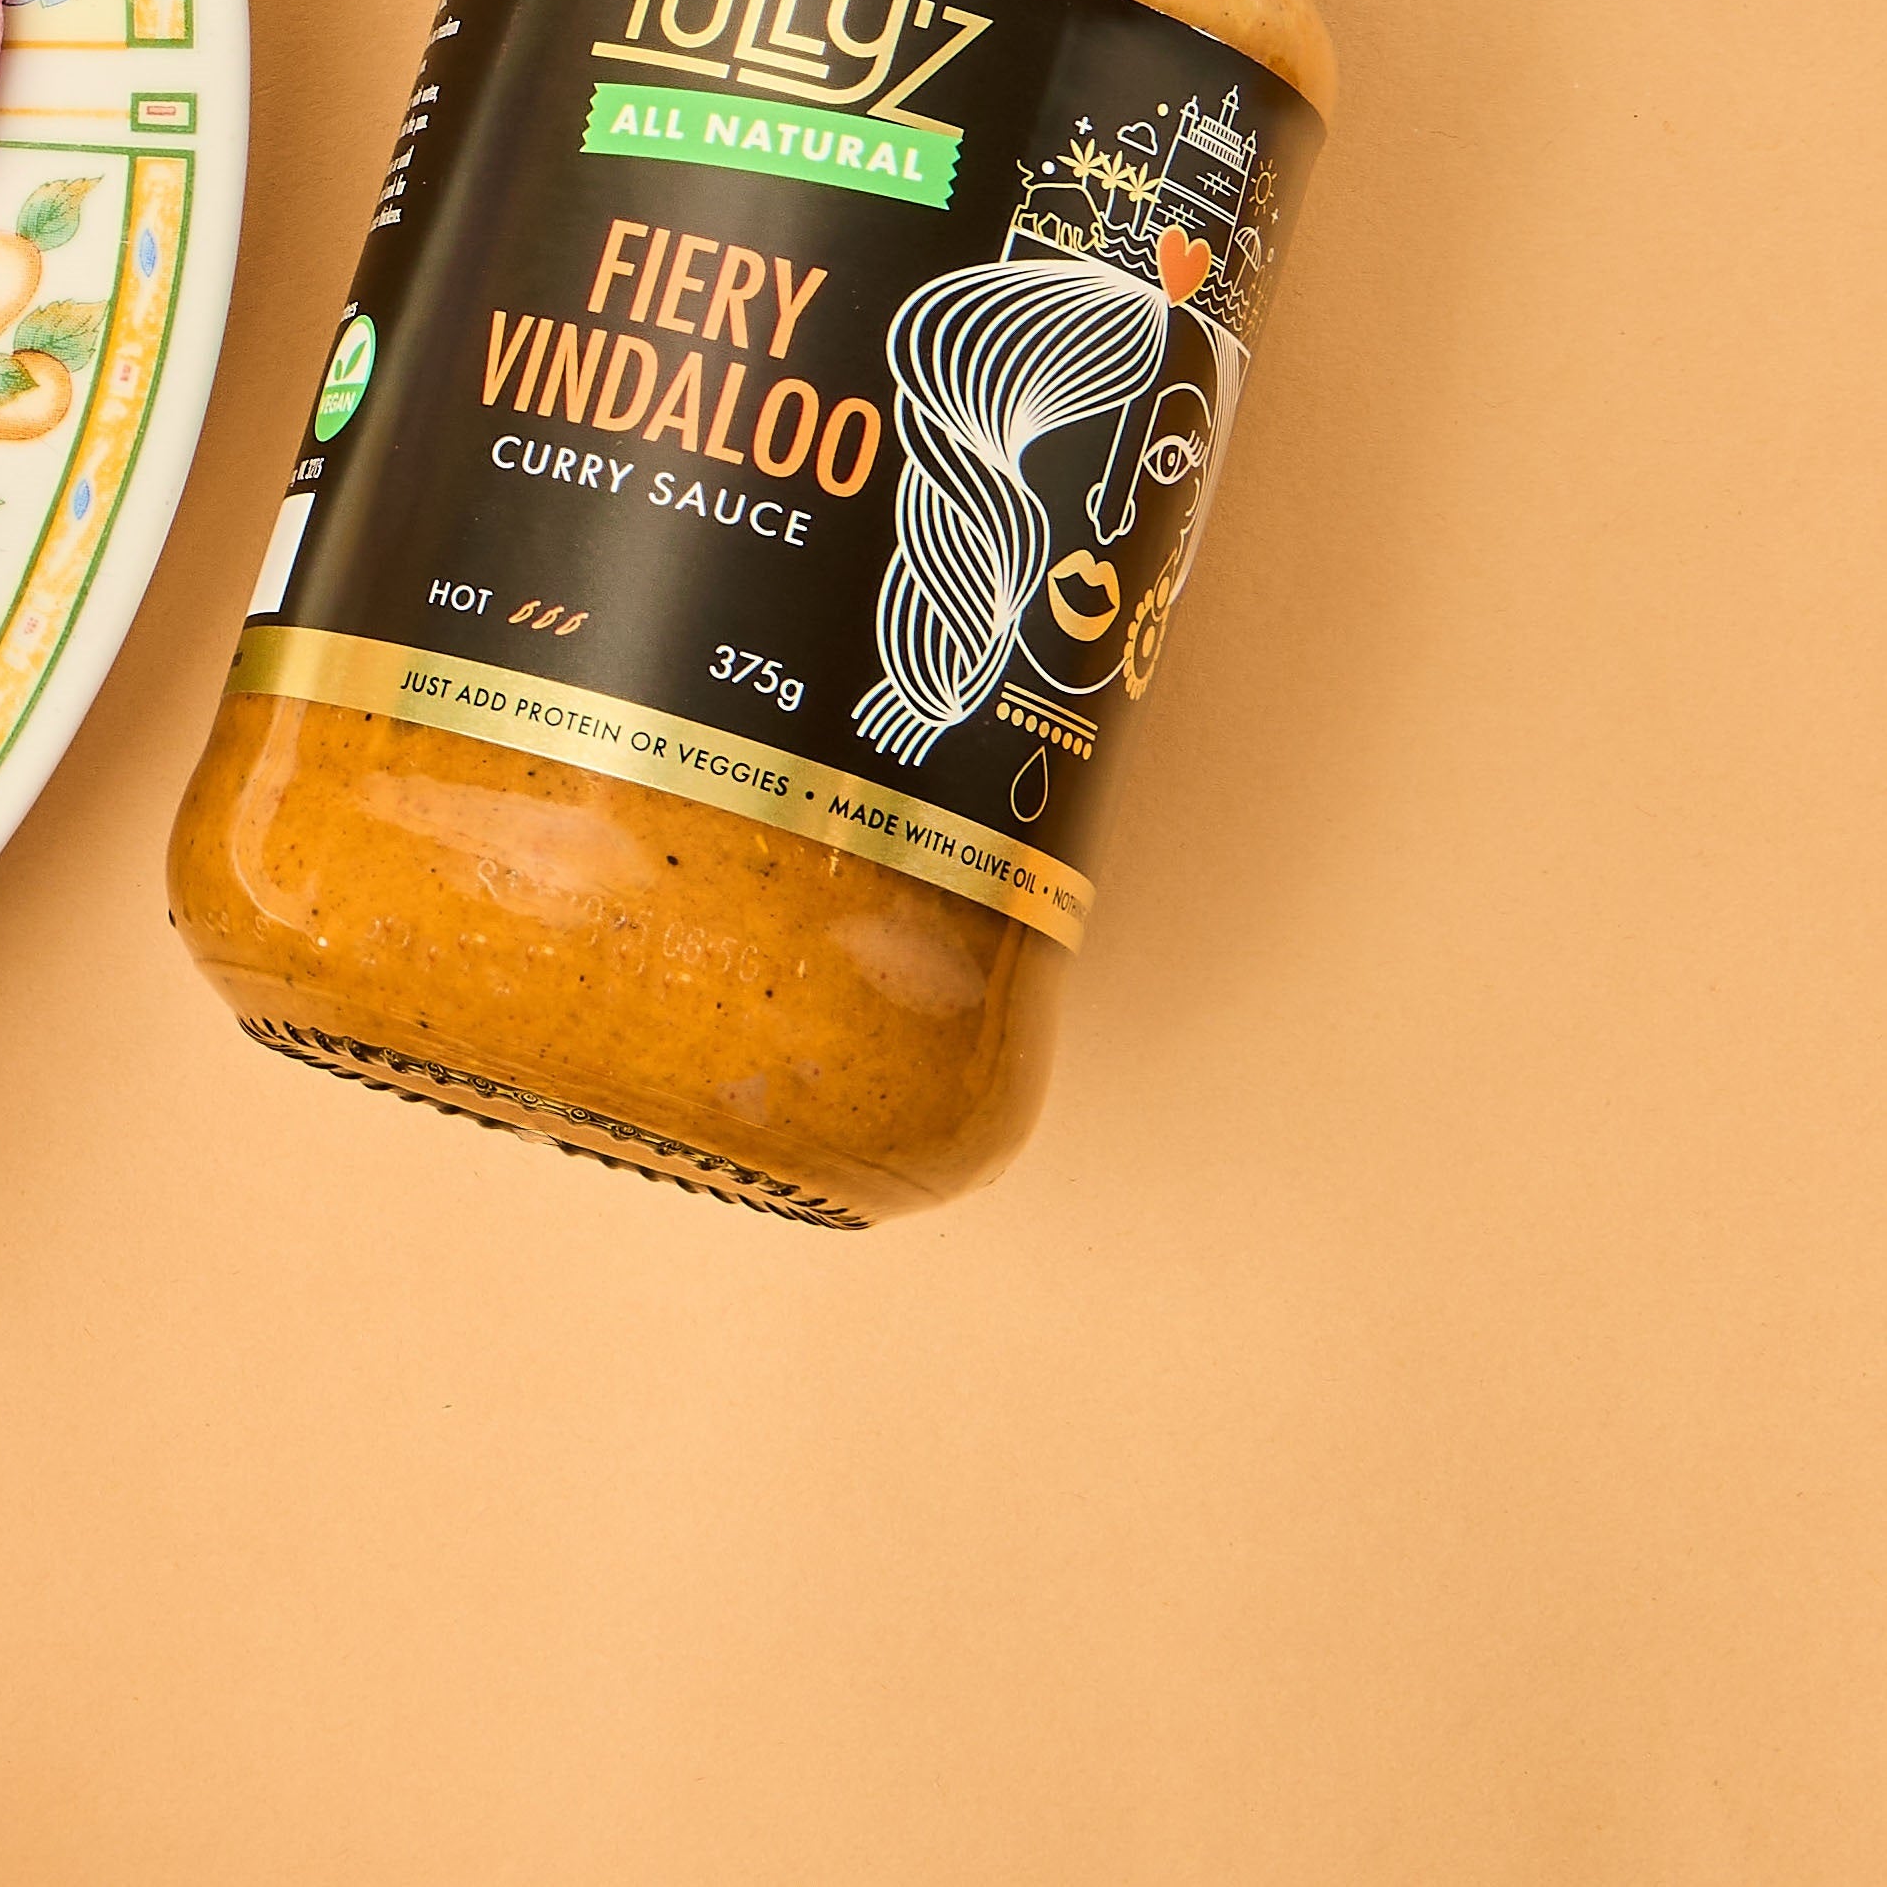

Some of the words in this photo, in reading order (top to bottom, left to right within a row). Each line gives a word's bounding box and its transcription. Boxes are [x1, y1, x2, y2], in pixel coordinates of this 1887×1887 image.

[610, 104, 685, 140] ALL
[704, 112, 924, 182] NATURAL
[587, 218, 828, 360] FIERY
[482, 310, 882, 498] VINDALOO
[491, 435, 634, 493] CURRY
[648, 472, 812, 546] SAUCE
[427, 579, 495, 615] HOT
[708, 644, 805, 713] 375g
[400, 670, 452, 699] JUST
[455, 685, 506, 712] ADD
[514, 699, 623, 744] PROTEIN
[631, 731, 667, 758] OR
[679, 743, 790, 798] VEGGIES
[828, 796, 899, 836] MADE
[906, 820, 956, 858] WITH
[961, 844, 1011, 882] OLIVE
[1013, 867, 1037, 895] OIL
